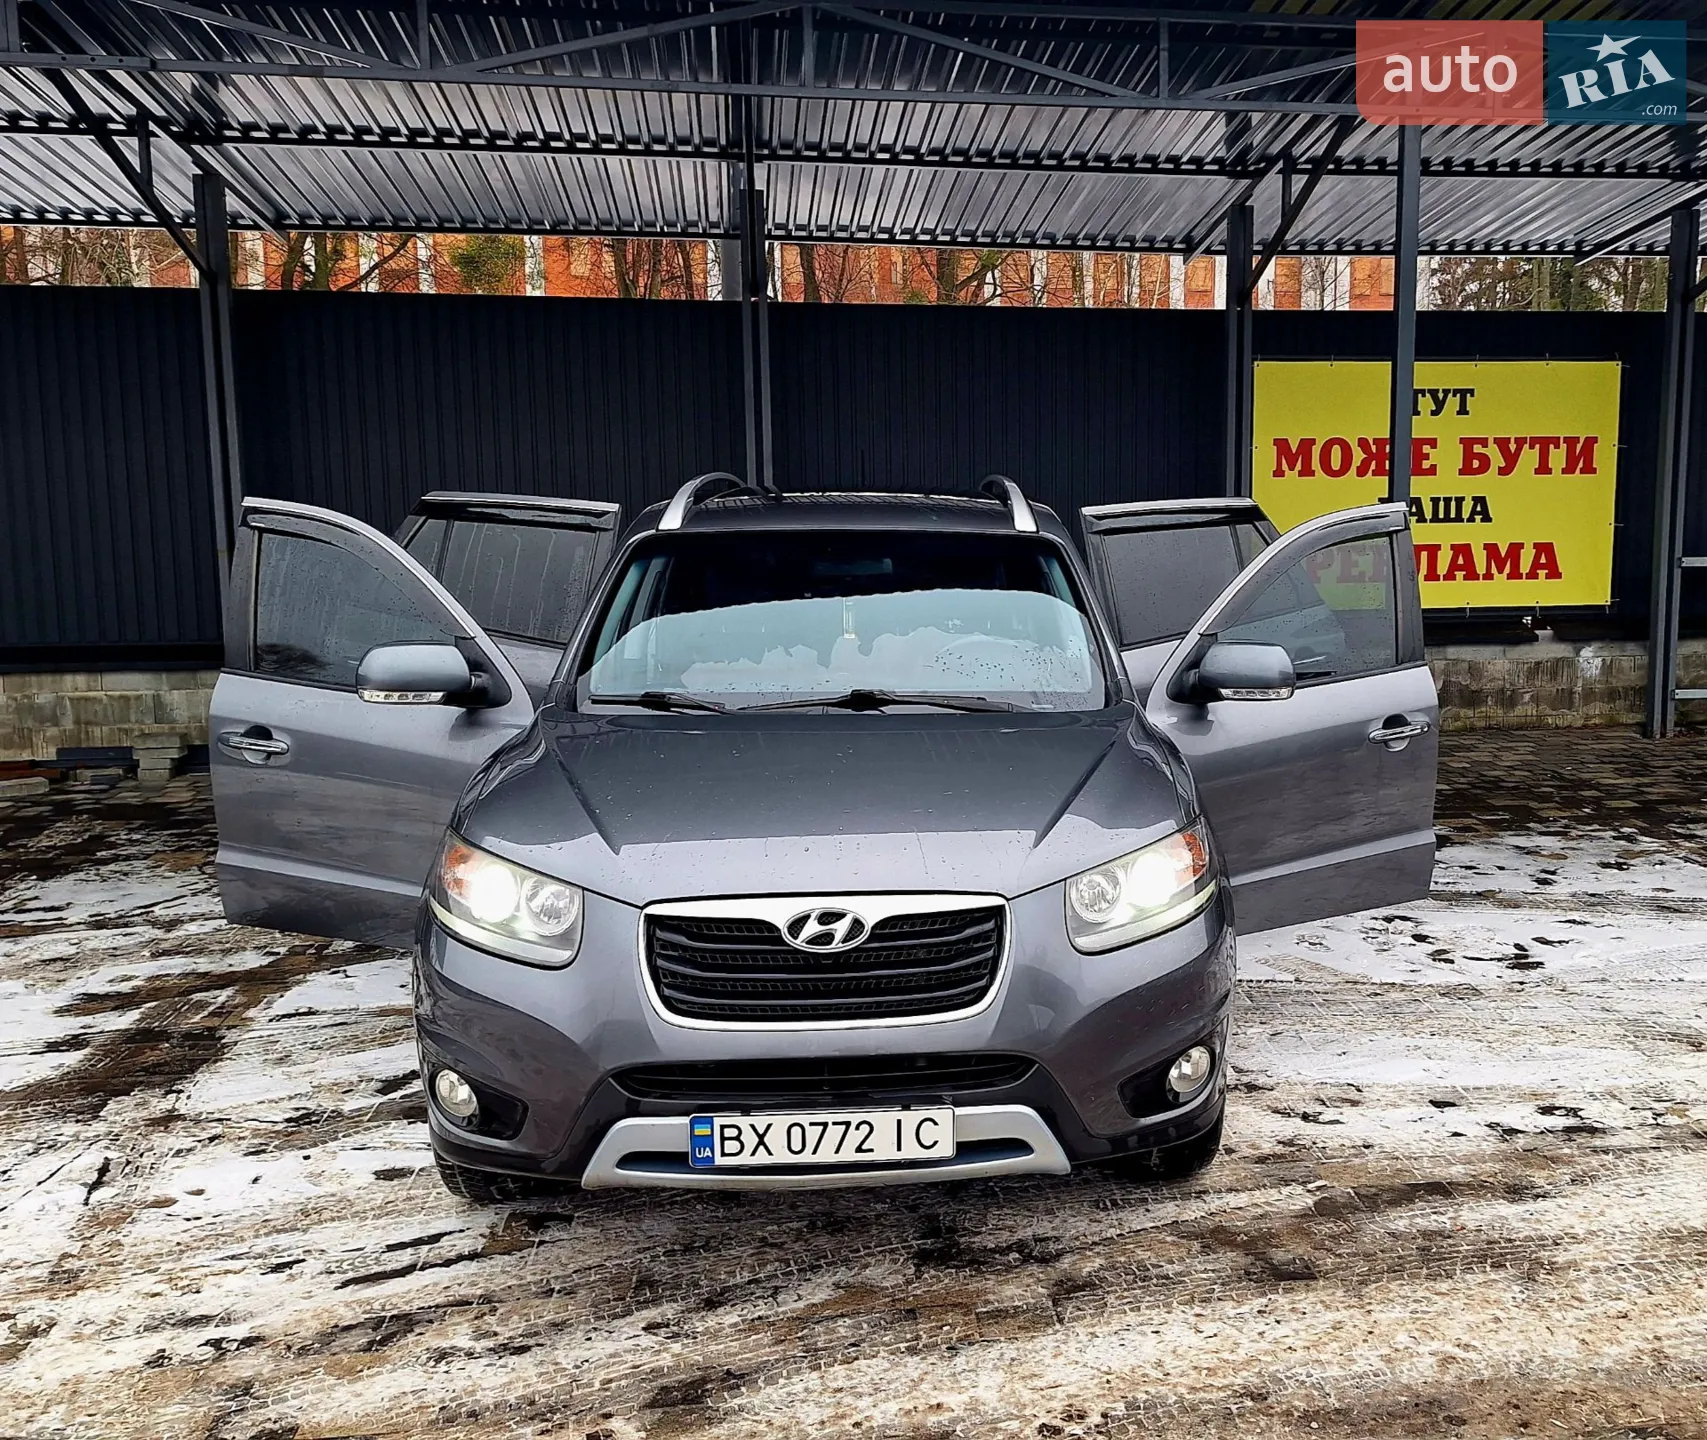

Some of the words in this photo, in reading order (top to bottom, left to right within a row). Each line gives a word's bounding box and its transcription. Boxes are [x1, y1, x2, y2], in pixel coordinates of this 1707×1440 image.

[1413, 388, 1475, 416] ТУТ
[1272, 437, 1438, 478] МОЖЕ
[1458, 436, 1599, 476] БУТИ
[1377, 496, 1493, 523] АША
[719, 1123, 774, 1157] BX
[786, 1120, 875, 1155] 0772
[896, 1117, 940, 1152] IC
[695, 1147, 713, 1158] UA
